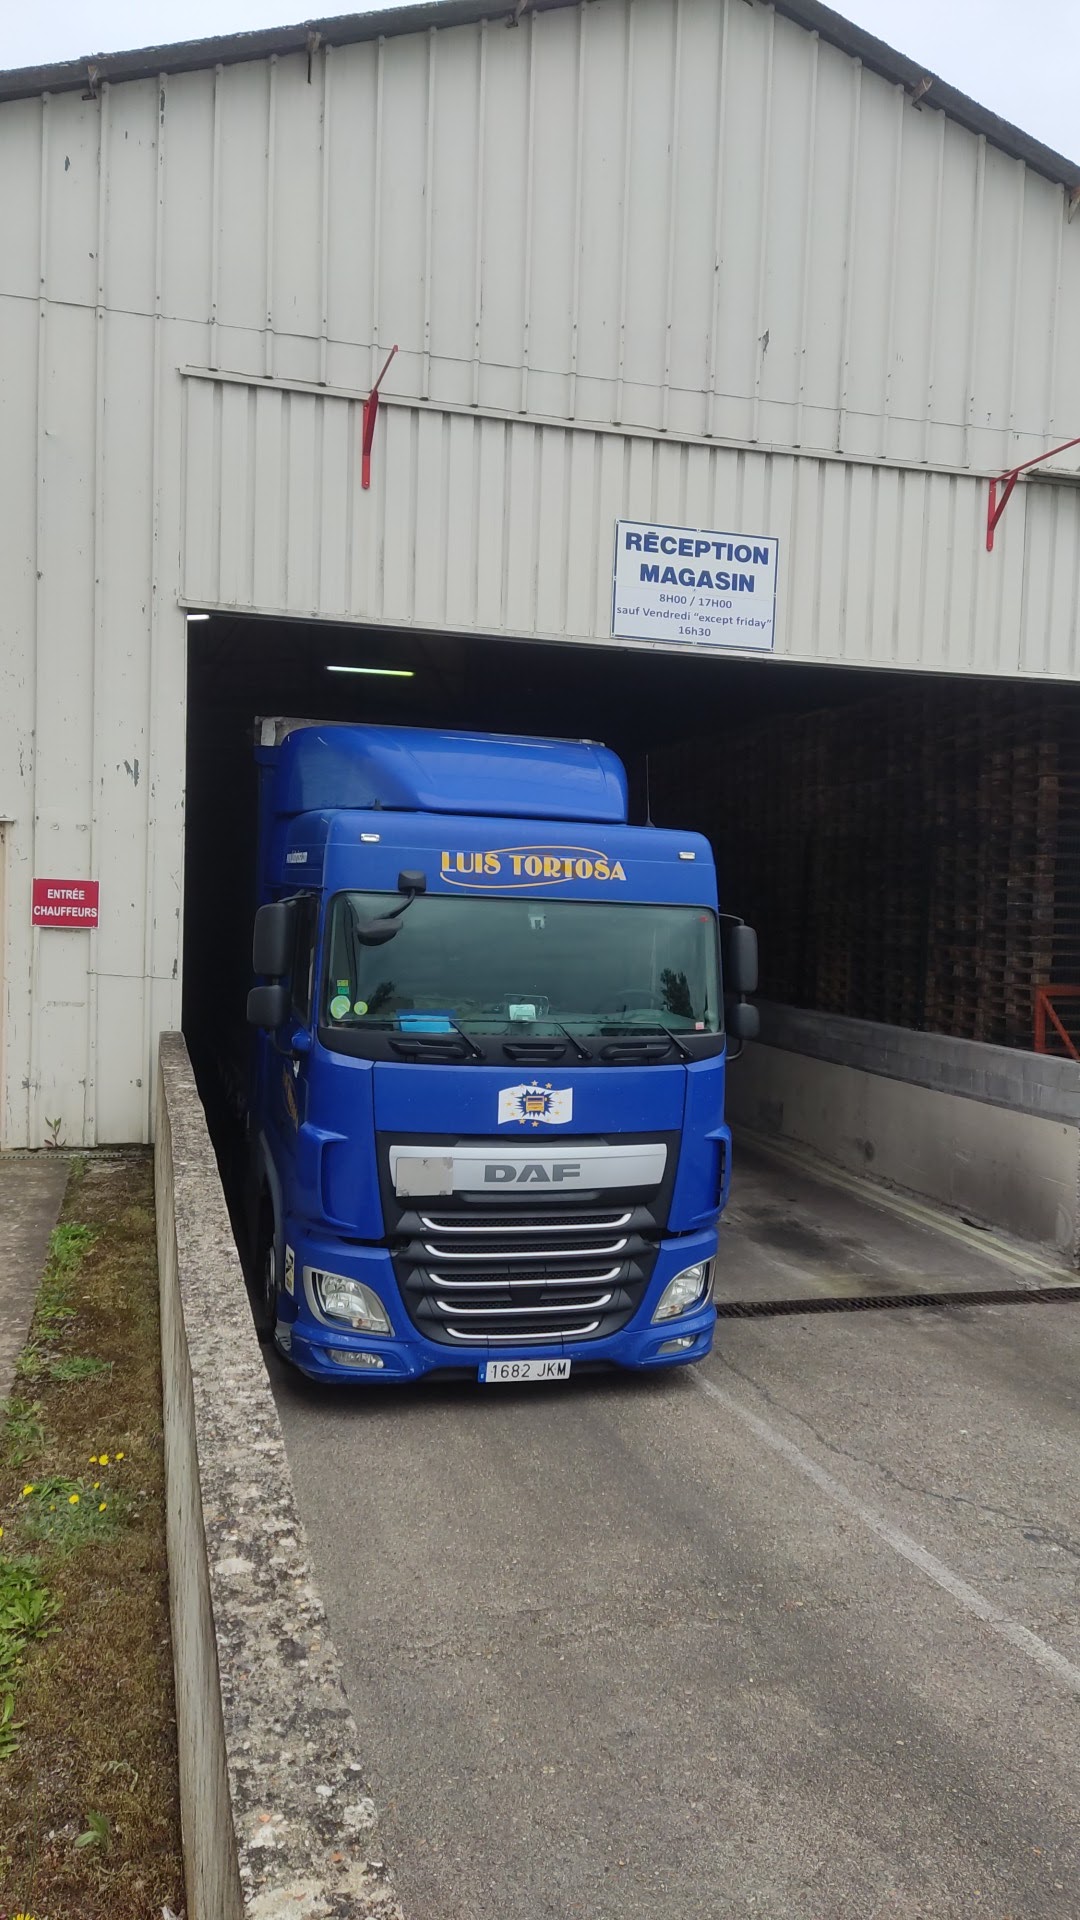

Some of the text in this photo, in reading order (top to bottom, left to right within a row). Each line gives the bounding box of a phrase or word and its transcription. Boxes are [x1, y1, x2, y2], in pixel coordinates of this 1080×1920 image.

[640, 564, 755, 592] MAGASIN
[659, 594, 732, 609] 8H00 / 17H00
[616, 606, 640, 615] sauf
[642, 608, 691, 621] Vendredi
[678, 626, 711, 637] 16h30
[441, 851, 627, 881] LUIS TORTOSA
[47, 888, 85, 900] ENTRÉE
[33, 905, 98, 918] CHAUFFEURS
[484, 1163, 581, 1183] DAF
[492, 1362, 567, 1379] 1682 JKM
